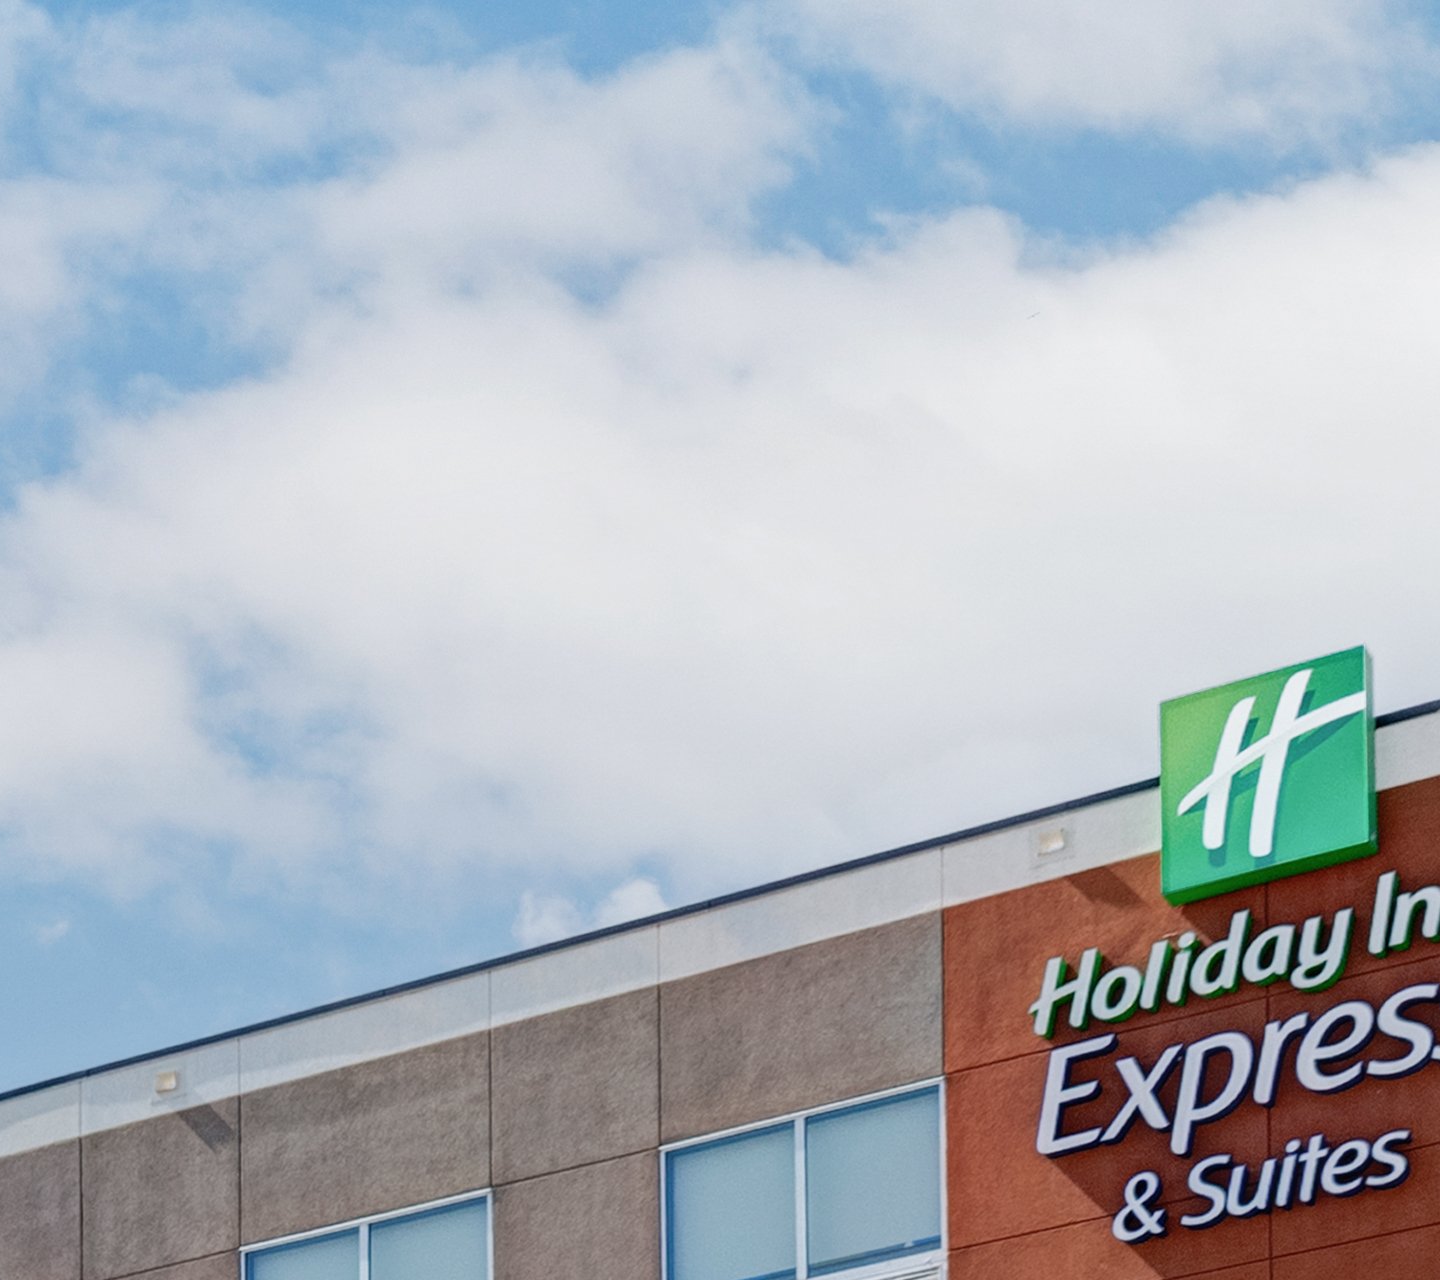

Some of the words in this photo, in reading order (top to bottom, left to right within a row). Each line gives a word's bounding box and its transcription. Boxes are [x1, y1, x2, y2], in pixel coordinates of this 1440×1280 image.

[1028, 908, 1353, 1037] Holiday
[1112, 1172, 1167, 1242] &
[1181, 1130, 1412, 1226] Suites
